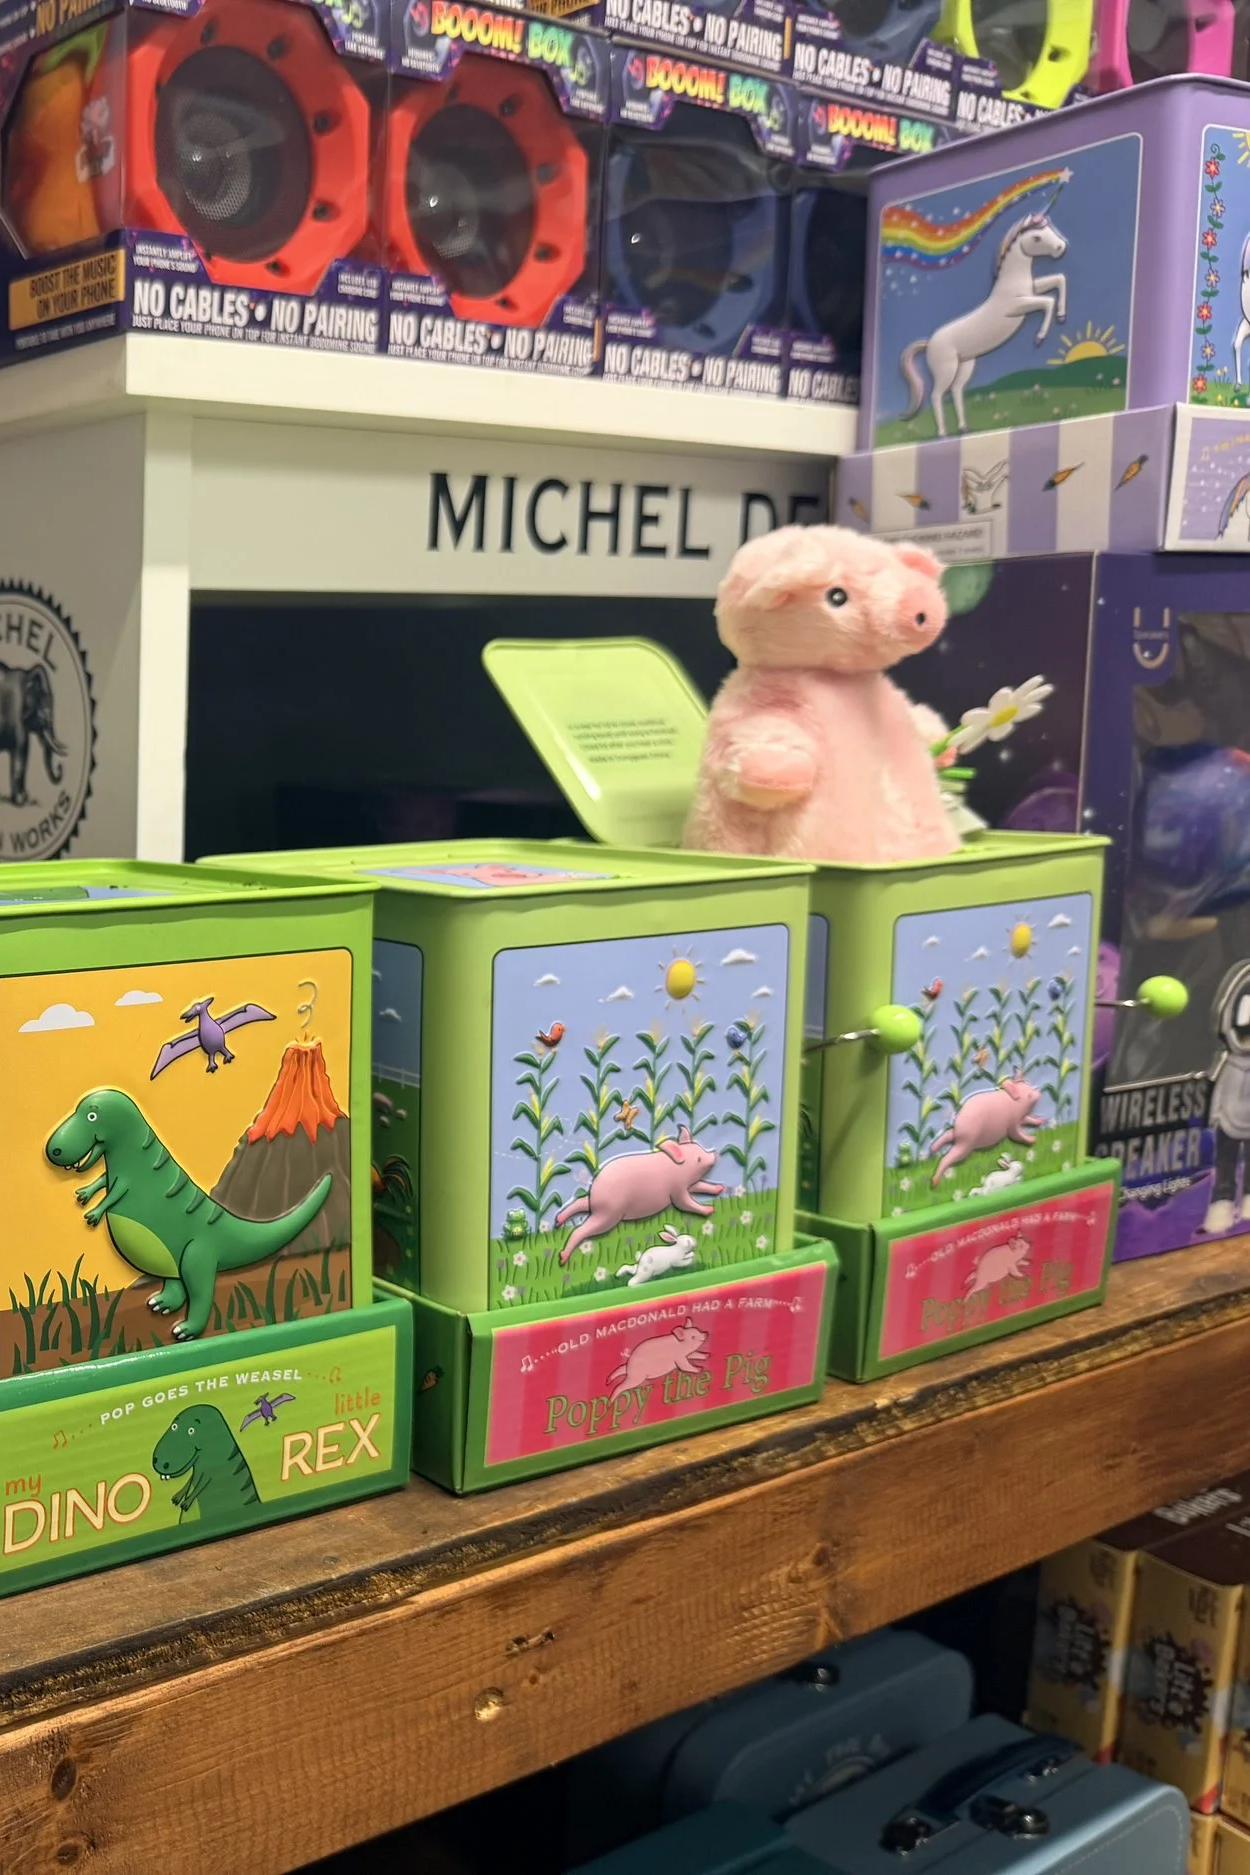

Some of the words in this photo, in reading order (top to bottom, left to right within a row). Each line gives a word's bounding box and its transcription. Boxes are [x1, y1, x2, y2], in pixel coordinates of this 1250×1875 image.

[632, 0, 691, 36] CABLES
[704, 13, 727, 45] NO
[728, 19, 783, 62] PAIRING
[528, 20, 575, 68] BOX
[794, 43, 817, 70] NO
[818, 48, 871, 86] CABLES
[729, 72, 769, 115] BOX
[882, 63, 903, 94] NO
[903, 69, 951, 108] PAIRING
[957, 91, 977, 120] NO
[29, 272, 60, 298] BOOST
[62, 266, 80, 287] THE
[82, 254, 117, 279] MUSIC
[52, 290, 79, 314] YOUR
[81, 279, 115, 306] PHONE
[133, 279, 167, 317] NO
[169, 282, 250, 328] CABLES
[271, 298, 300, 333] NO
[302, 300, 379, 344] PAIRING
[132, 314, 152, 329] JUST
[154, 316, 178, 332] PLACE
[180, 320, 202, 336] YOUR
[204, 322, 231, 339] PHONE
[232, 327, 244, 340] ON
[245, 328, 260, 342] TOP
[261, 330, 276, 344] FOR
[278, 332, 309, 348] INSTANT
[389, 310, 419, 347] NO
[420, 313, 488, 356] CABLES
[504, 328, 533, 360] NO
[533, 331, 593, 367] PAIRING
[604, 342, 630, 374] NO
[631, 345, 691, 382] CABLES
[702, 355, 726, 386] NO
[726, 358, 782, 394] PAIRING
[788, 366, 811, 397] NO
[426, 471, 712, 561] MICHEL
[10, 790, 73, 854] WORKS
[1100, 1081, 1209, 1134] WIRELESS
[557, 1332, 590, 1355] OLD
[595, 1304, 687, 1339] MACDONALD
[692, 1298, 721, 1314] HAD
[723, 1298, 734, 1310] A
[738, 1297, 774, 1310] FARM
[99, 1402, 135, 1426] POP
[141, 1384, 189, 1409] GOES
[195, 1376, 229, 1395] THE
[235, 1368, 303, 1386] WEASEL
[334, 1387, 382, 1417] little
[543, 1380, 655, 1436] Poppy
[662, 1368, 712, 1405] the
[723, 1350, 772, 1394] Pig
[279, 1413, 382, 1482] REX
[4, 1474, 43, 1499] my
[2, 1472, 152, 1556] DINO
